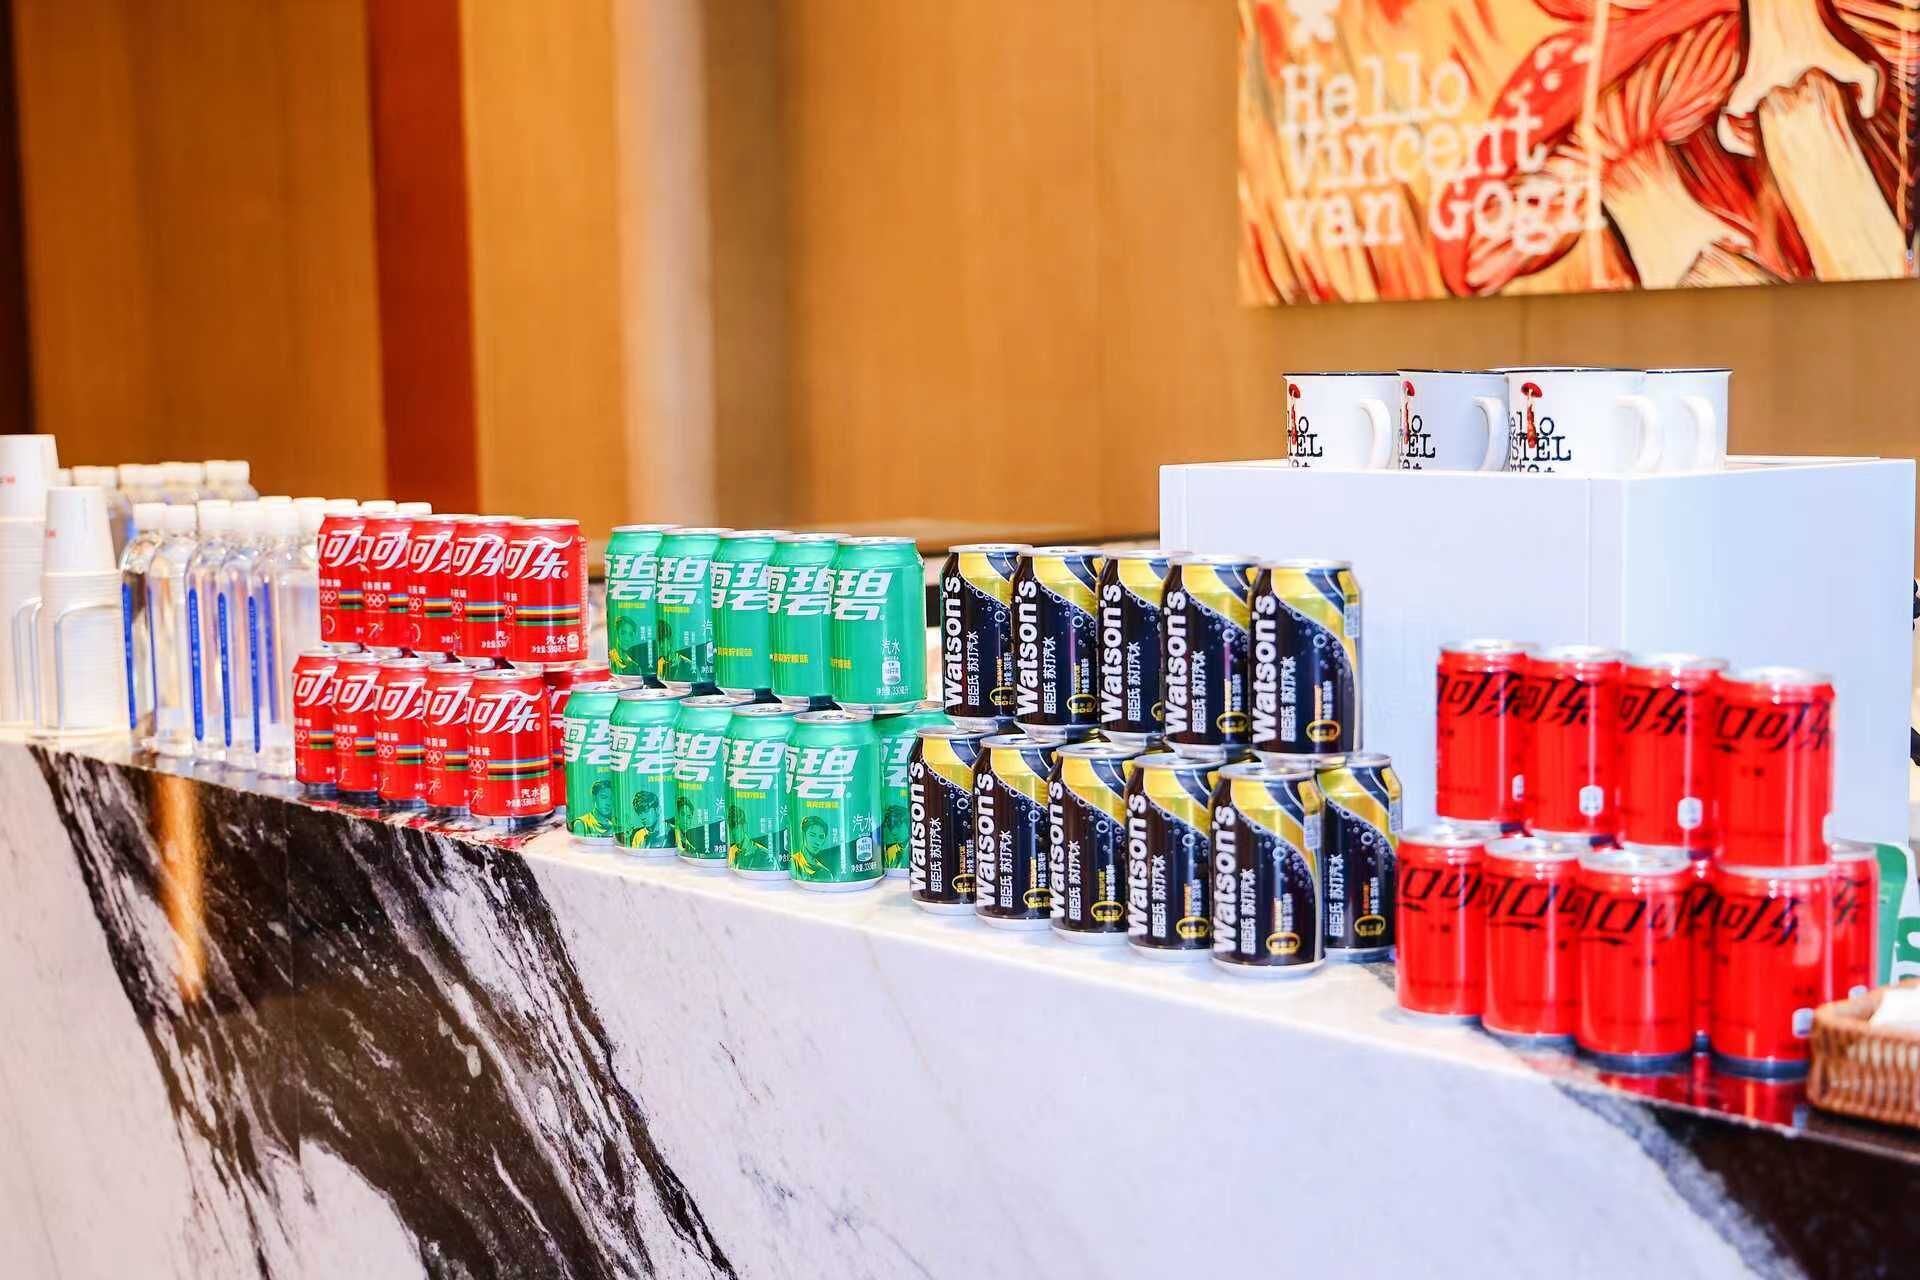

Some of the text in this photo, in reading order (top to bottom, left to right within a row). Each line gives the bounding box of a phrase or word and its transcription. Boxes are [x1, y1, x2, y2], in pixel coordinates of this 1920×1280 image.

[1282, 53, 1469, 131] Hello
[1284, 101, 1546, 189] Vincent
[1286, 191, 1404, 249] van
[604, 551, 659, 600] 碧
[827, 568, 894, 622] 碧
[881, 639, 901, 656] 汽水
[944, 575, 963, 709] Watson's
[966, 630, 981, 707] 屈臣氏 苏打汽水
[1016, 579, 1040, 717] Watson's
[1042, 635, 1057, 715] 屈臣氏 苏打汽水
[1100, 584, 1124, 723] Watson's
[1127, 640, 1141, 722] 屈臣氏 苏打汽水
[1164, 590, 1188, 736] Watson's
[1252, 594, 1277, 744] Watson's
[467, 688, 543, 735] 可乐
[1190, 649, 1207, 734] 屈臣氏 苏打汽水
[1437, 671, 1522, 717] 可乐
[722, 736, 787, 790] 碧
[852, 812, 874, 834] 汽水
[909, 761, 927, 893] Watson's
[929, 817, 942, 893] 屈臣氏 苏打汽水
[975, 771, 996, 907] Watson's
[1049, 780, 1065, 918] Watson's
[999, 830, 1013, 909] 屈臣氏 苏打汽水
[1068, 840, 1081, 921] 屈臣氏 苏打汽水
[1127, 793, 1148, 937] Watson's
[1151, 854, 1167, 938] 屈臣氏 苏打汽水
[1212, 804, 1237, 954] Watson's
[1328, 854, 1345, 937] 屈臣氏 苏打汽水
[1240, 868, 1257, 955] 屈臣氏 苏打汽水
